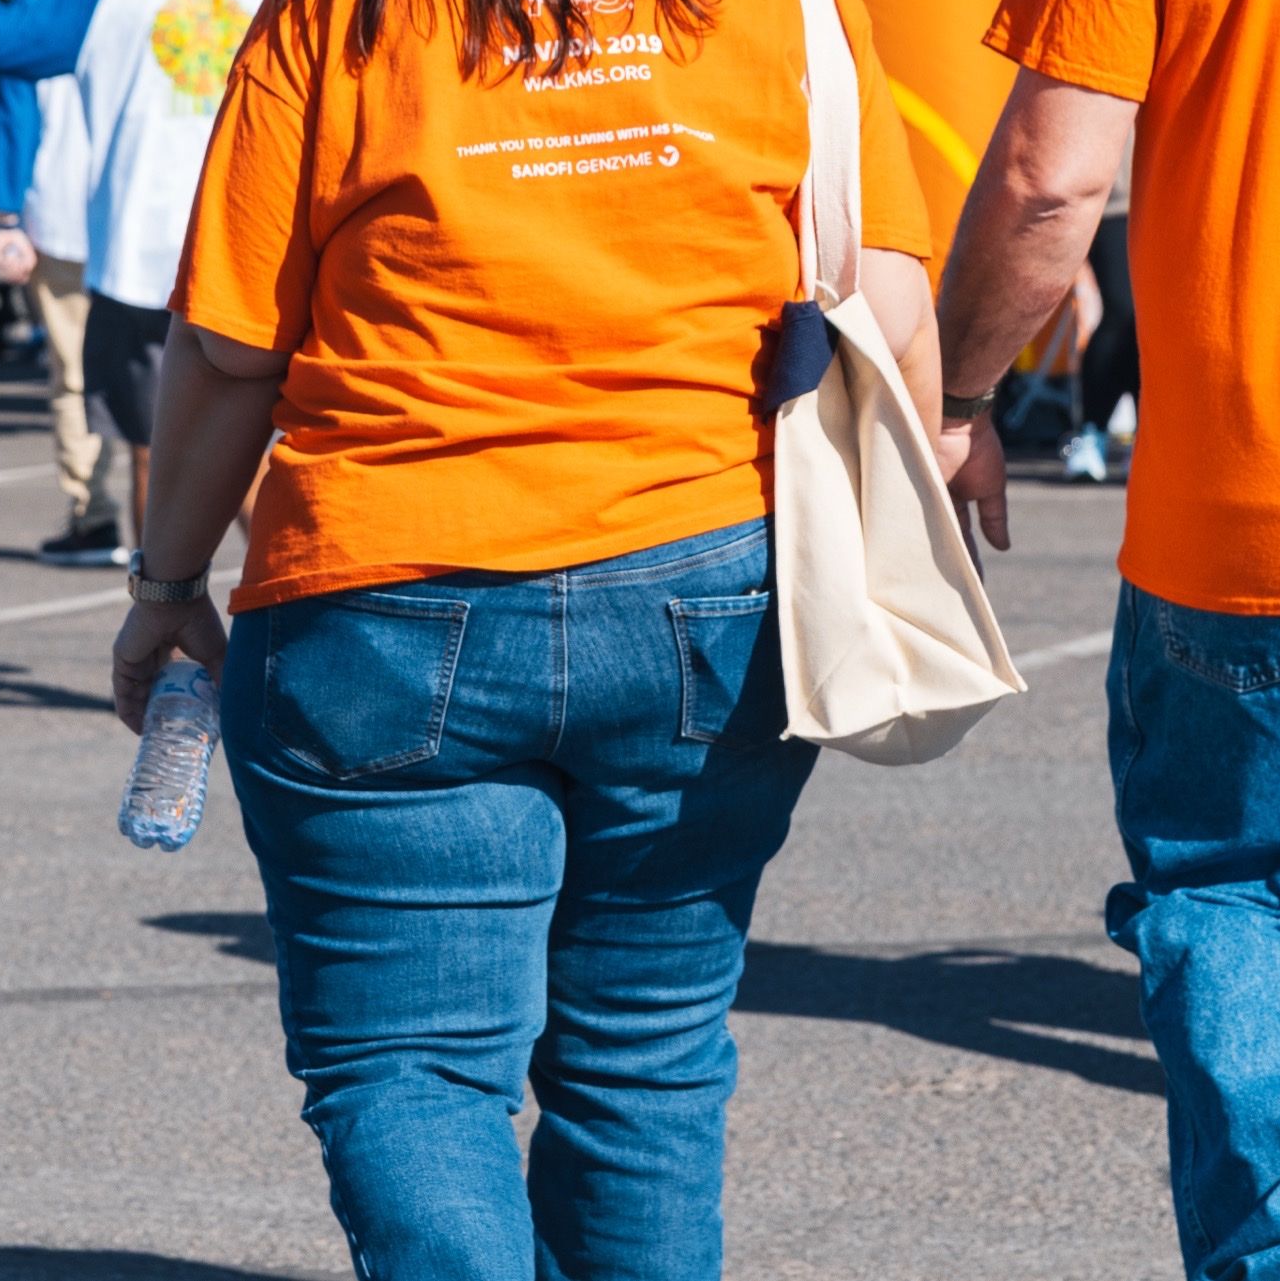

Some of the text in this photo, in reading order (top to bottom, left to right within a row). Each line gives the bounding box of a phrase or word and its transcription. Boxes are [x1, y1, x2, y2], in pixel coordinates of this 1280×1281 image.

[503, 33, 663, 65] NVDA 2019
[524, 64, 652, 92] WALKMS.ORG
[456, 141, 498, 158] THANK
[500, 139, 525, 152] YOU
[527, 137, 544, 150] TO
[545, 135, 572, 149] OUR
[573, 131, 615, 146] LIVING
[616, 126, 649, 141] WITH
[651, 123, 670, 136] MS
[511, 151, 654, 179] SANOFI GENZYME
